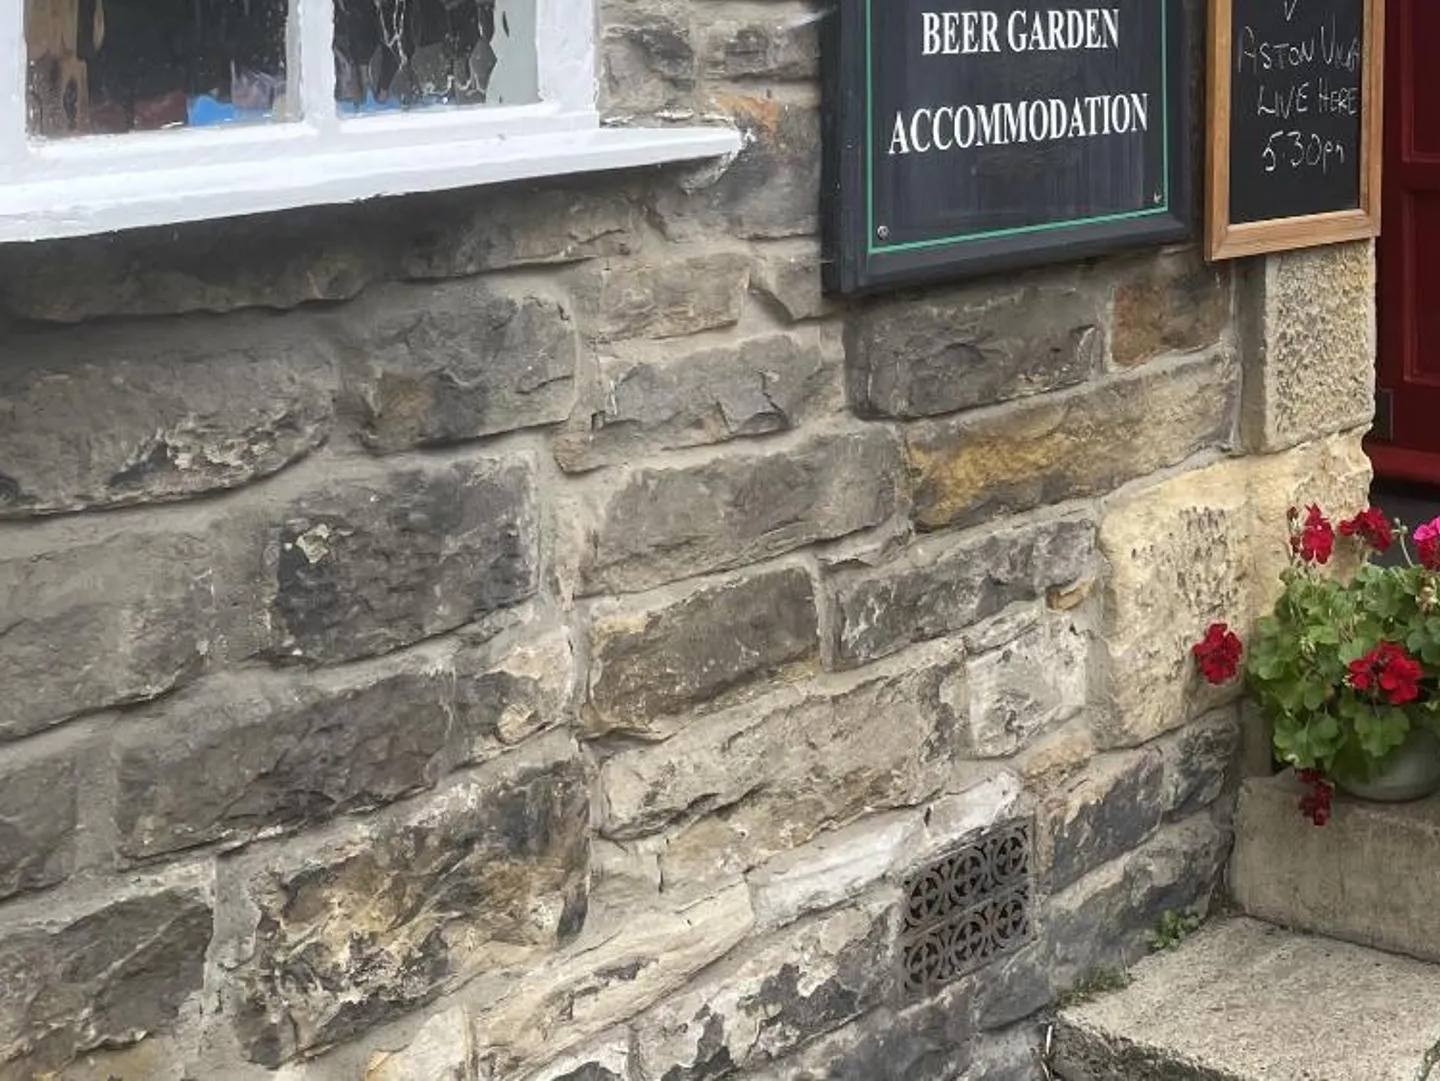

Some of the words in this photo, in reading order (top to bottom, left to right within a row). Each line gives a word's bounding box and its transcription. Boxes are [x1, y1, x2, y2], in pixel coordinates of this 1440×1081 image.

[922, 11, 1000, 56] BEER
[1007, 8, 1120, 52] GARDEN
[1257, 82, 1310, 119] LIVE
[1318, 77, 1359, 115] HERE
[888, 93, 1149, 155] ACCOMMODATION
